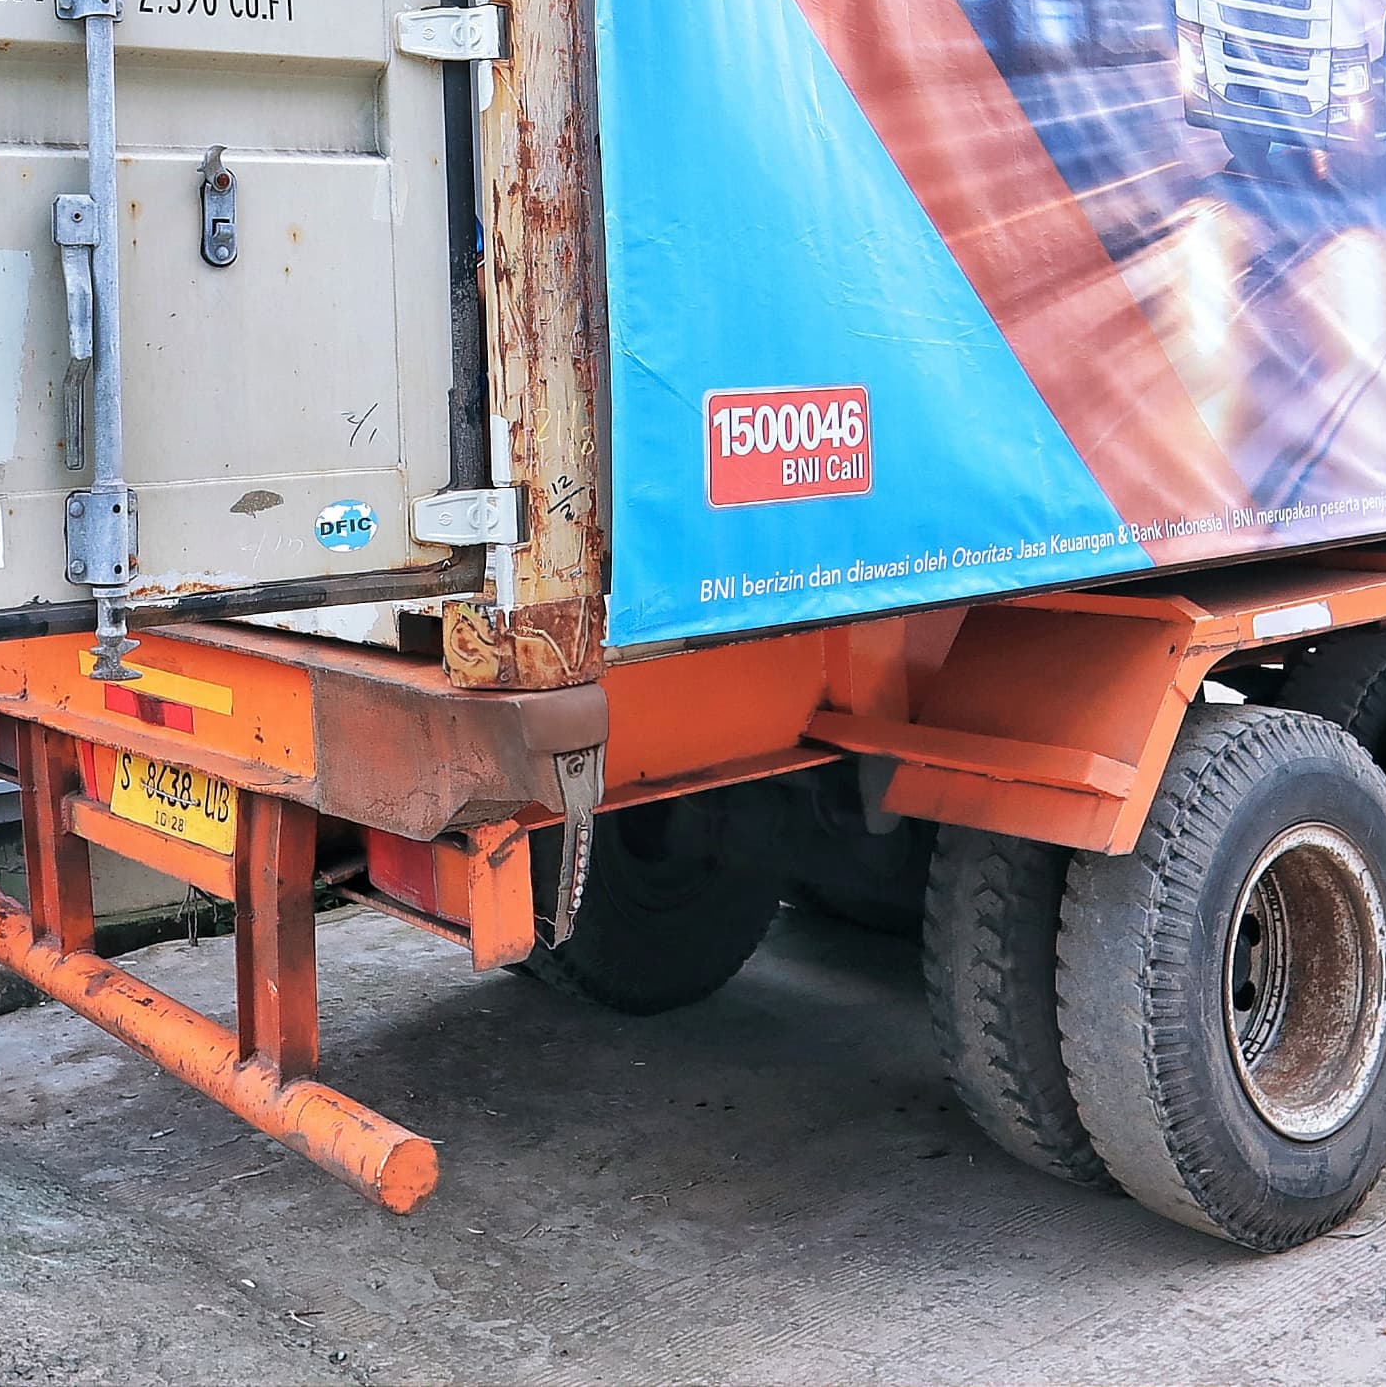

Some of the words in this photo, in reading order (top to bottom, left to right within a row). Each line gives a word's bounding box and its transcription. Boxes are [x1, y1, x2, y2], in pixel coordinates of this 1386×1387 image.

[713, 399, 864, 457] 1500046
[782, 457, 820, 486] BNI
[826, 453, 864, 482] Call
[320, 517, 373, 536] DFIC
[1232, 507, 1254, 528] BNI
[1256, 500, 1318, 527] merupakan
[1320, 496, 1360, 521] peserta
[699, 577, 735, 603] BNI
[742, 569, 804, 596] berizin
[808, 563, 841, 587] dan
[846, 554, 910, 582] diawasi
[914, 547, 947, 573] oleh
[952, 543, 1013, 568] Otoritas
[1016, 539, 1046, 560] Jasa
[1050, 527, 1115, 556] Keuangan
[1117, 522, 1129, 545] &
[1131, 519, 1163, 542] Bank
[1165, 511, 1223, 537] Indonesia
[121, 752, 132, 791] S
[204, 777, 230, 823] UB
